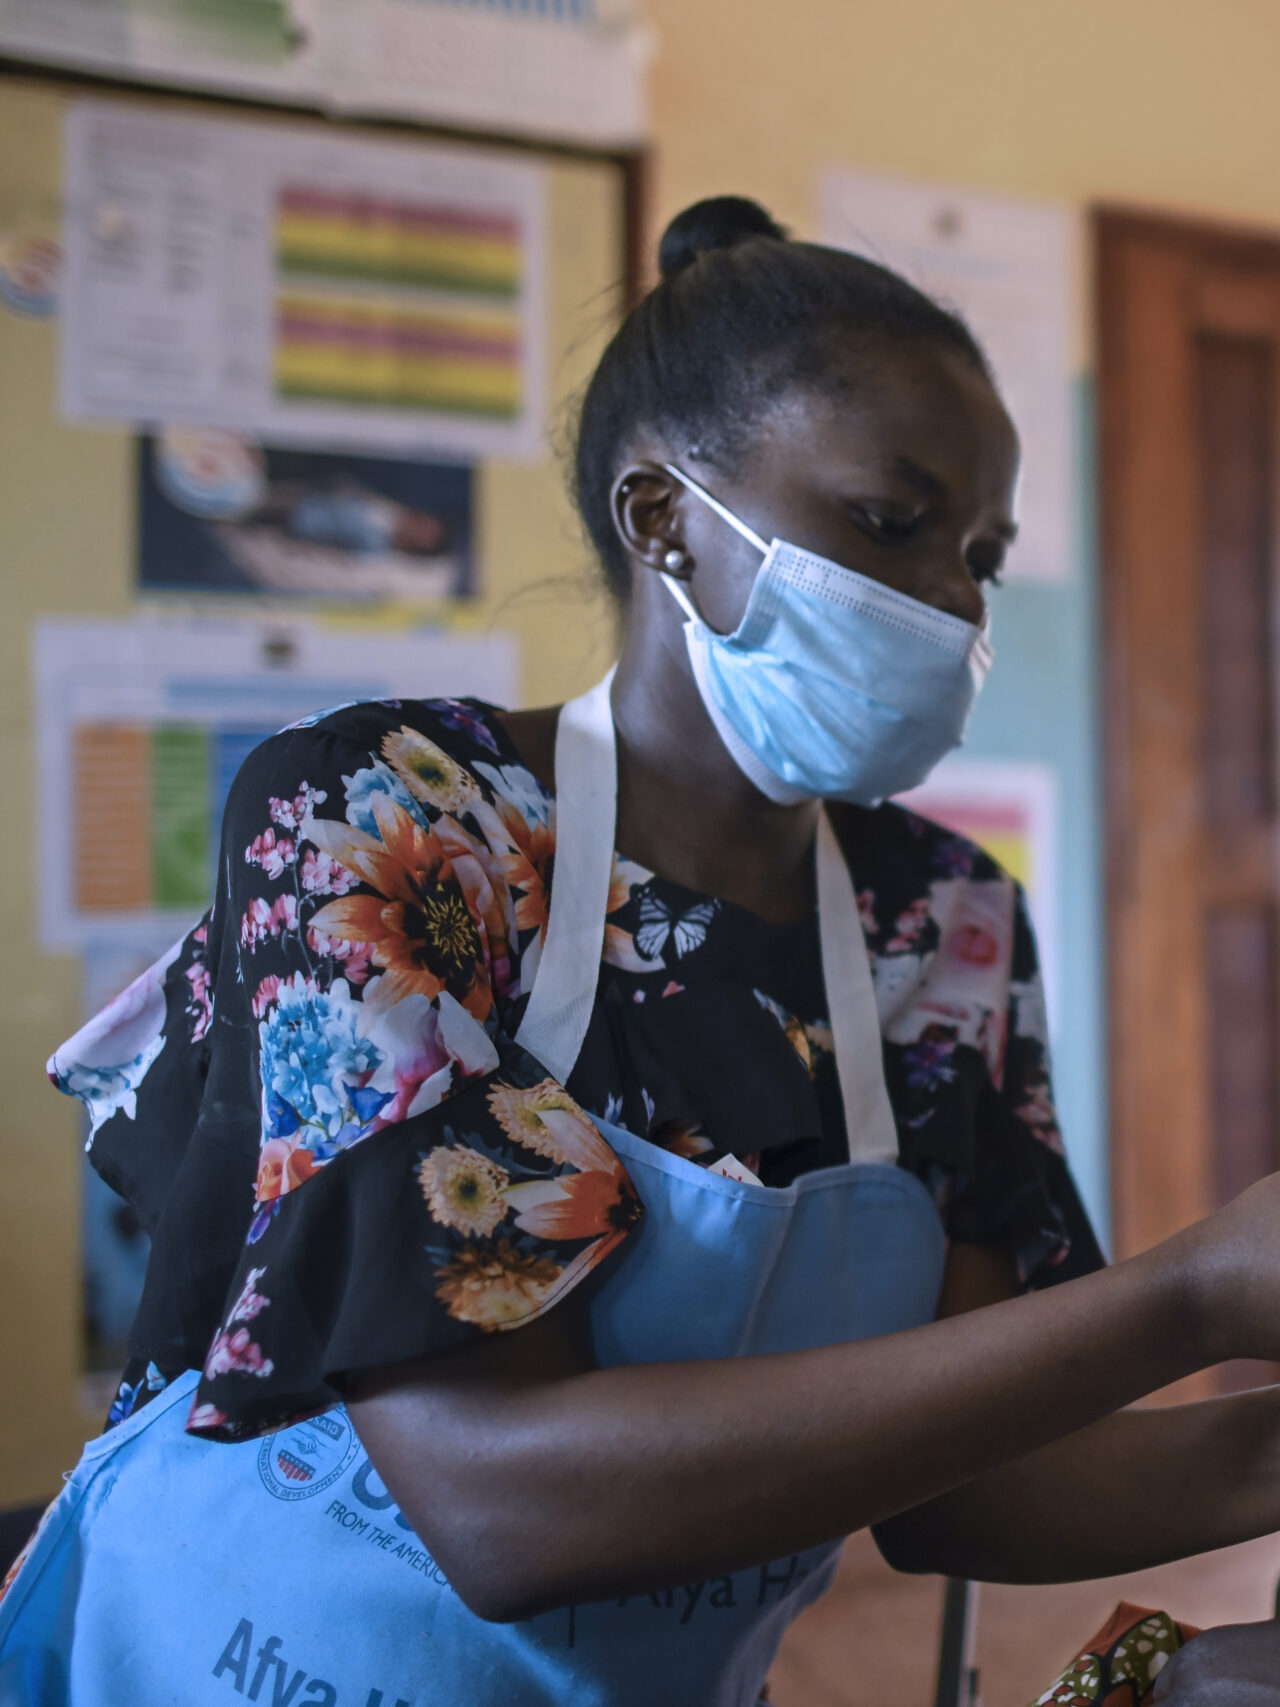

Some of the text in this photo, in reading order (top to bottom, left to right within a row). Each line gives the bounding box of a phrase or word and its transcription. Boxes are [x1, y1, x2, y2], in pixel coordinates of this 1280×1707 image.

[309, 1416, 339, 1436] SAID
[280, 1465, 345, 1499] DEVELOPMENT
[324, 1500, 455, 1591] FROM THE AMERIC
